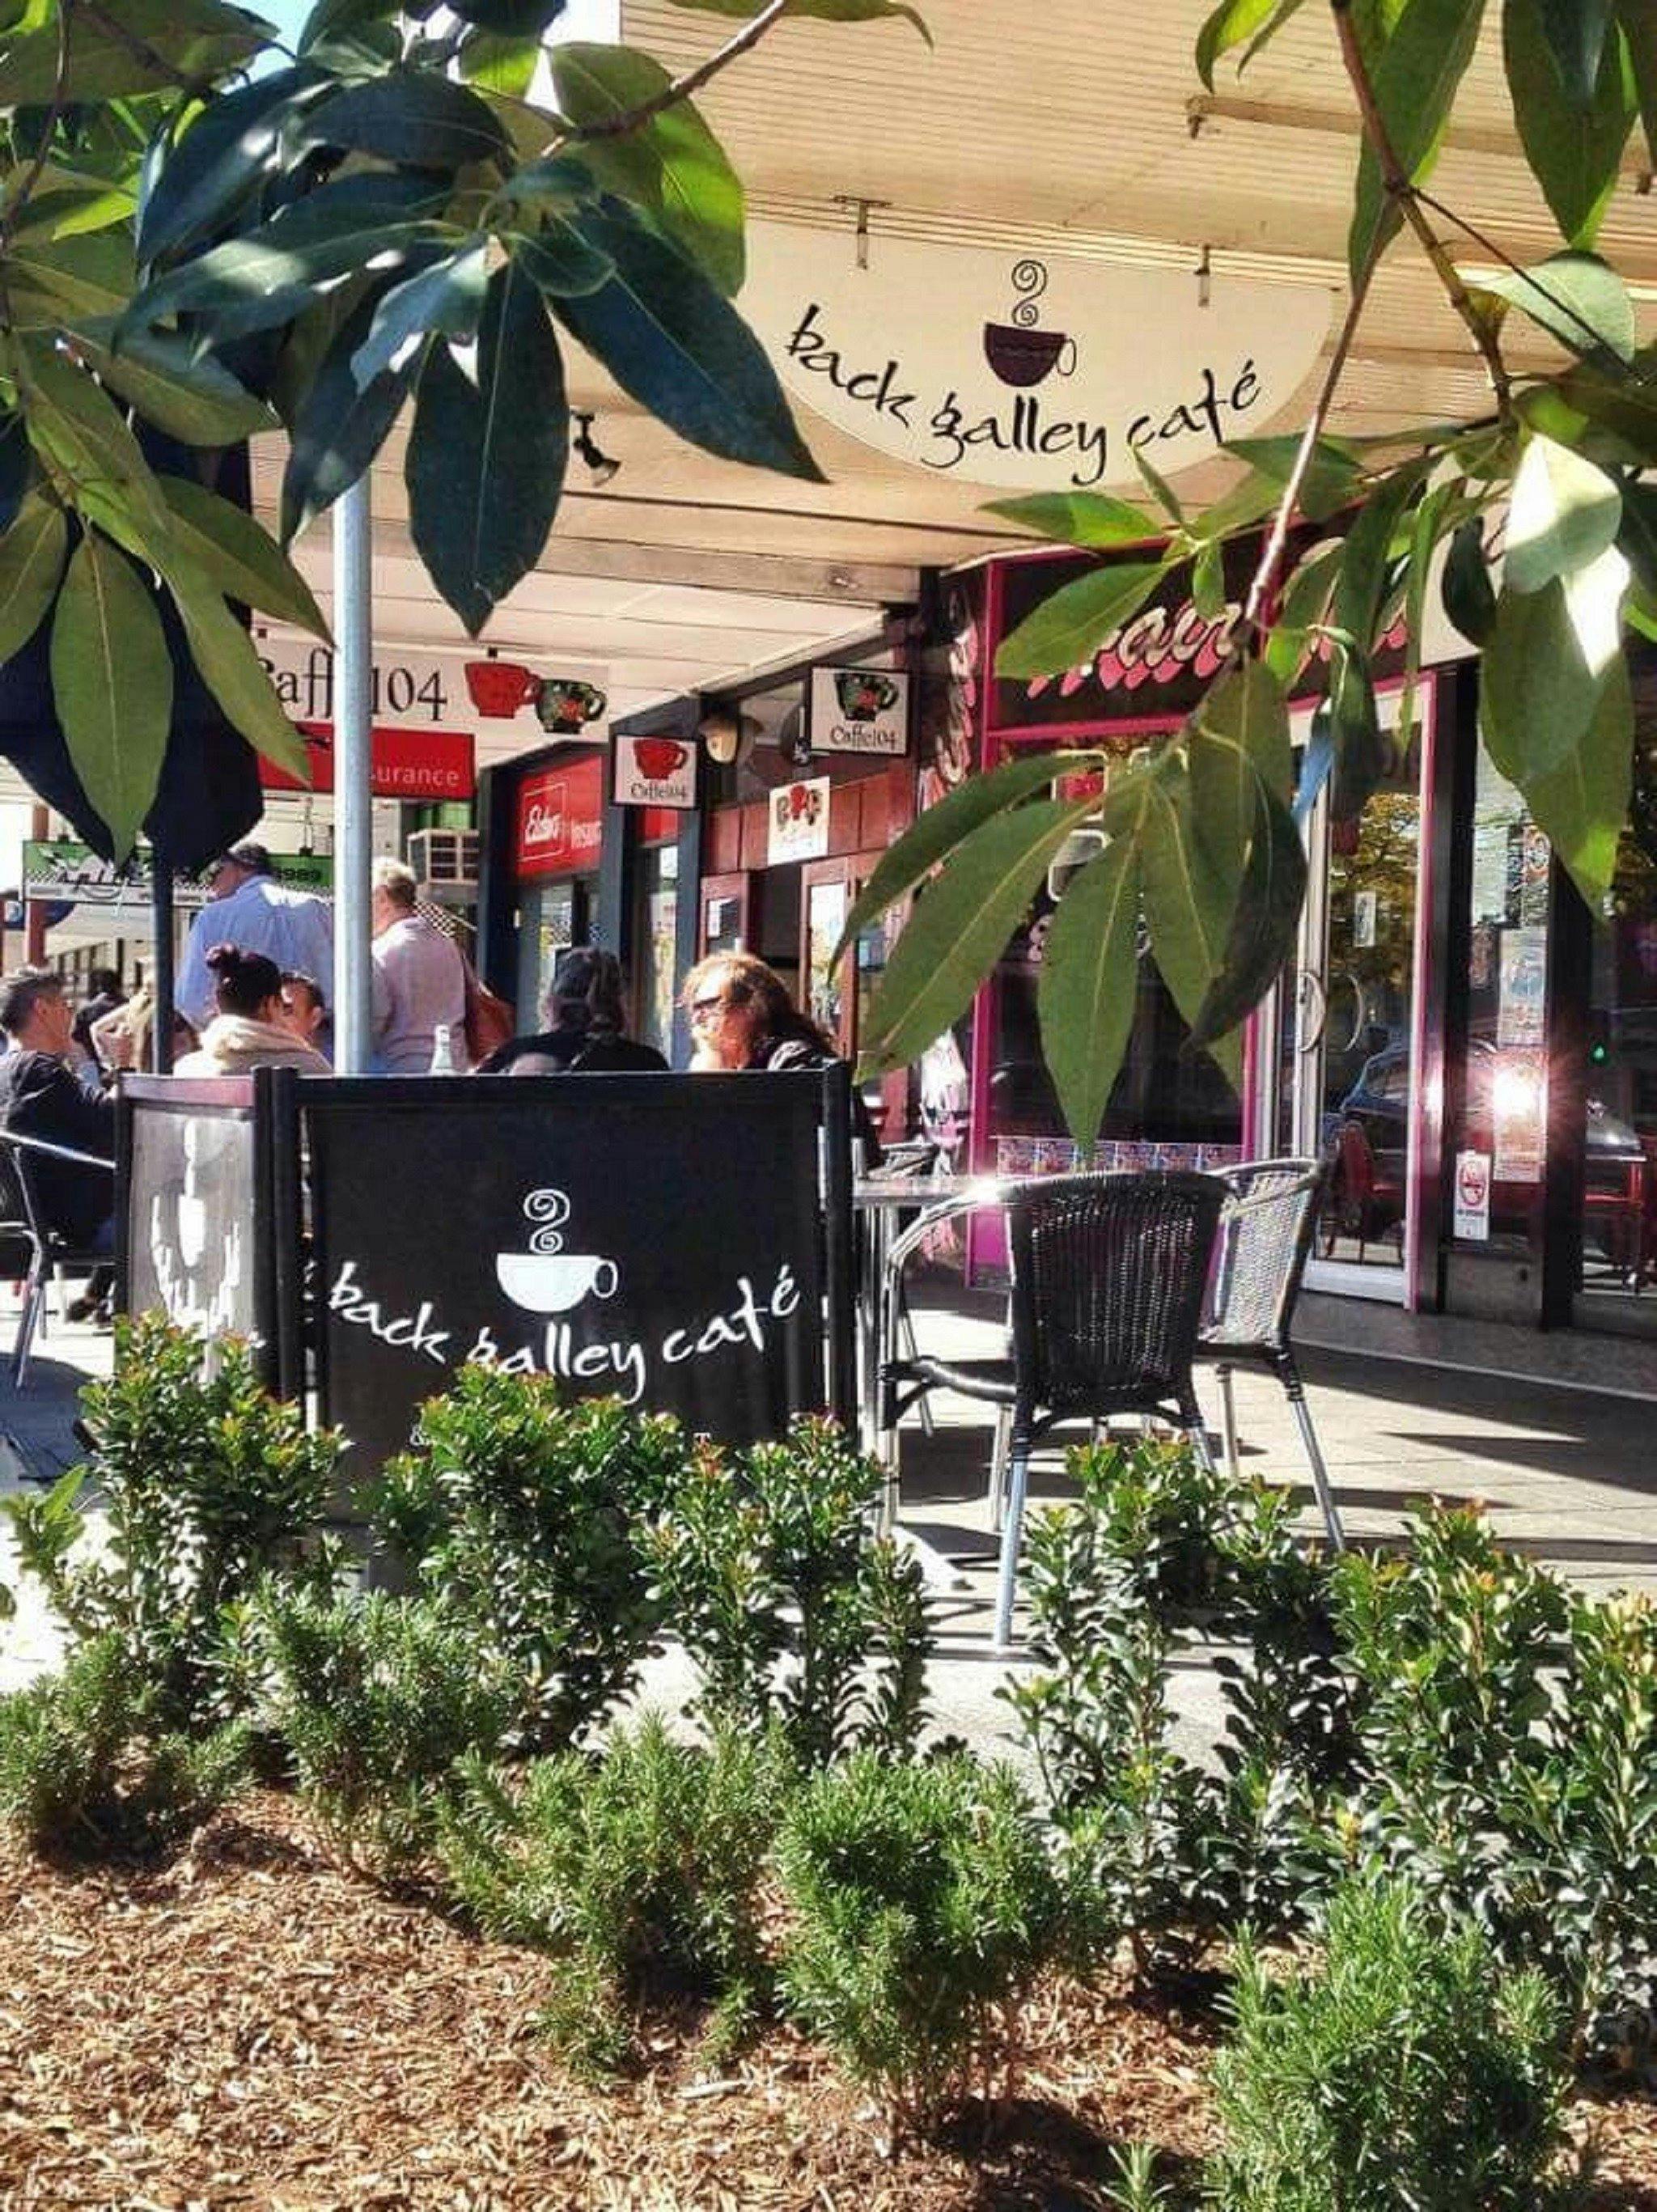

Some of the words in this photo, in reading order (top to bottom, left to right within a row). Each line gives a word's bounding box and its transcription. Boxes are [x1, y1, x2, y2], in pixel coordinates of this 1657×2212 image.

[784, 303, 916, 429] back
[921, 392, 1107, 485] galley
[1126, 358, 1261, 447] café
[328, 1261, 451, 1365] back
[662, 1265, 799, 1357] café
